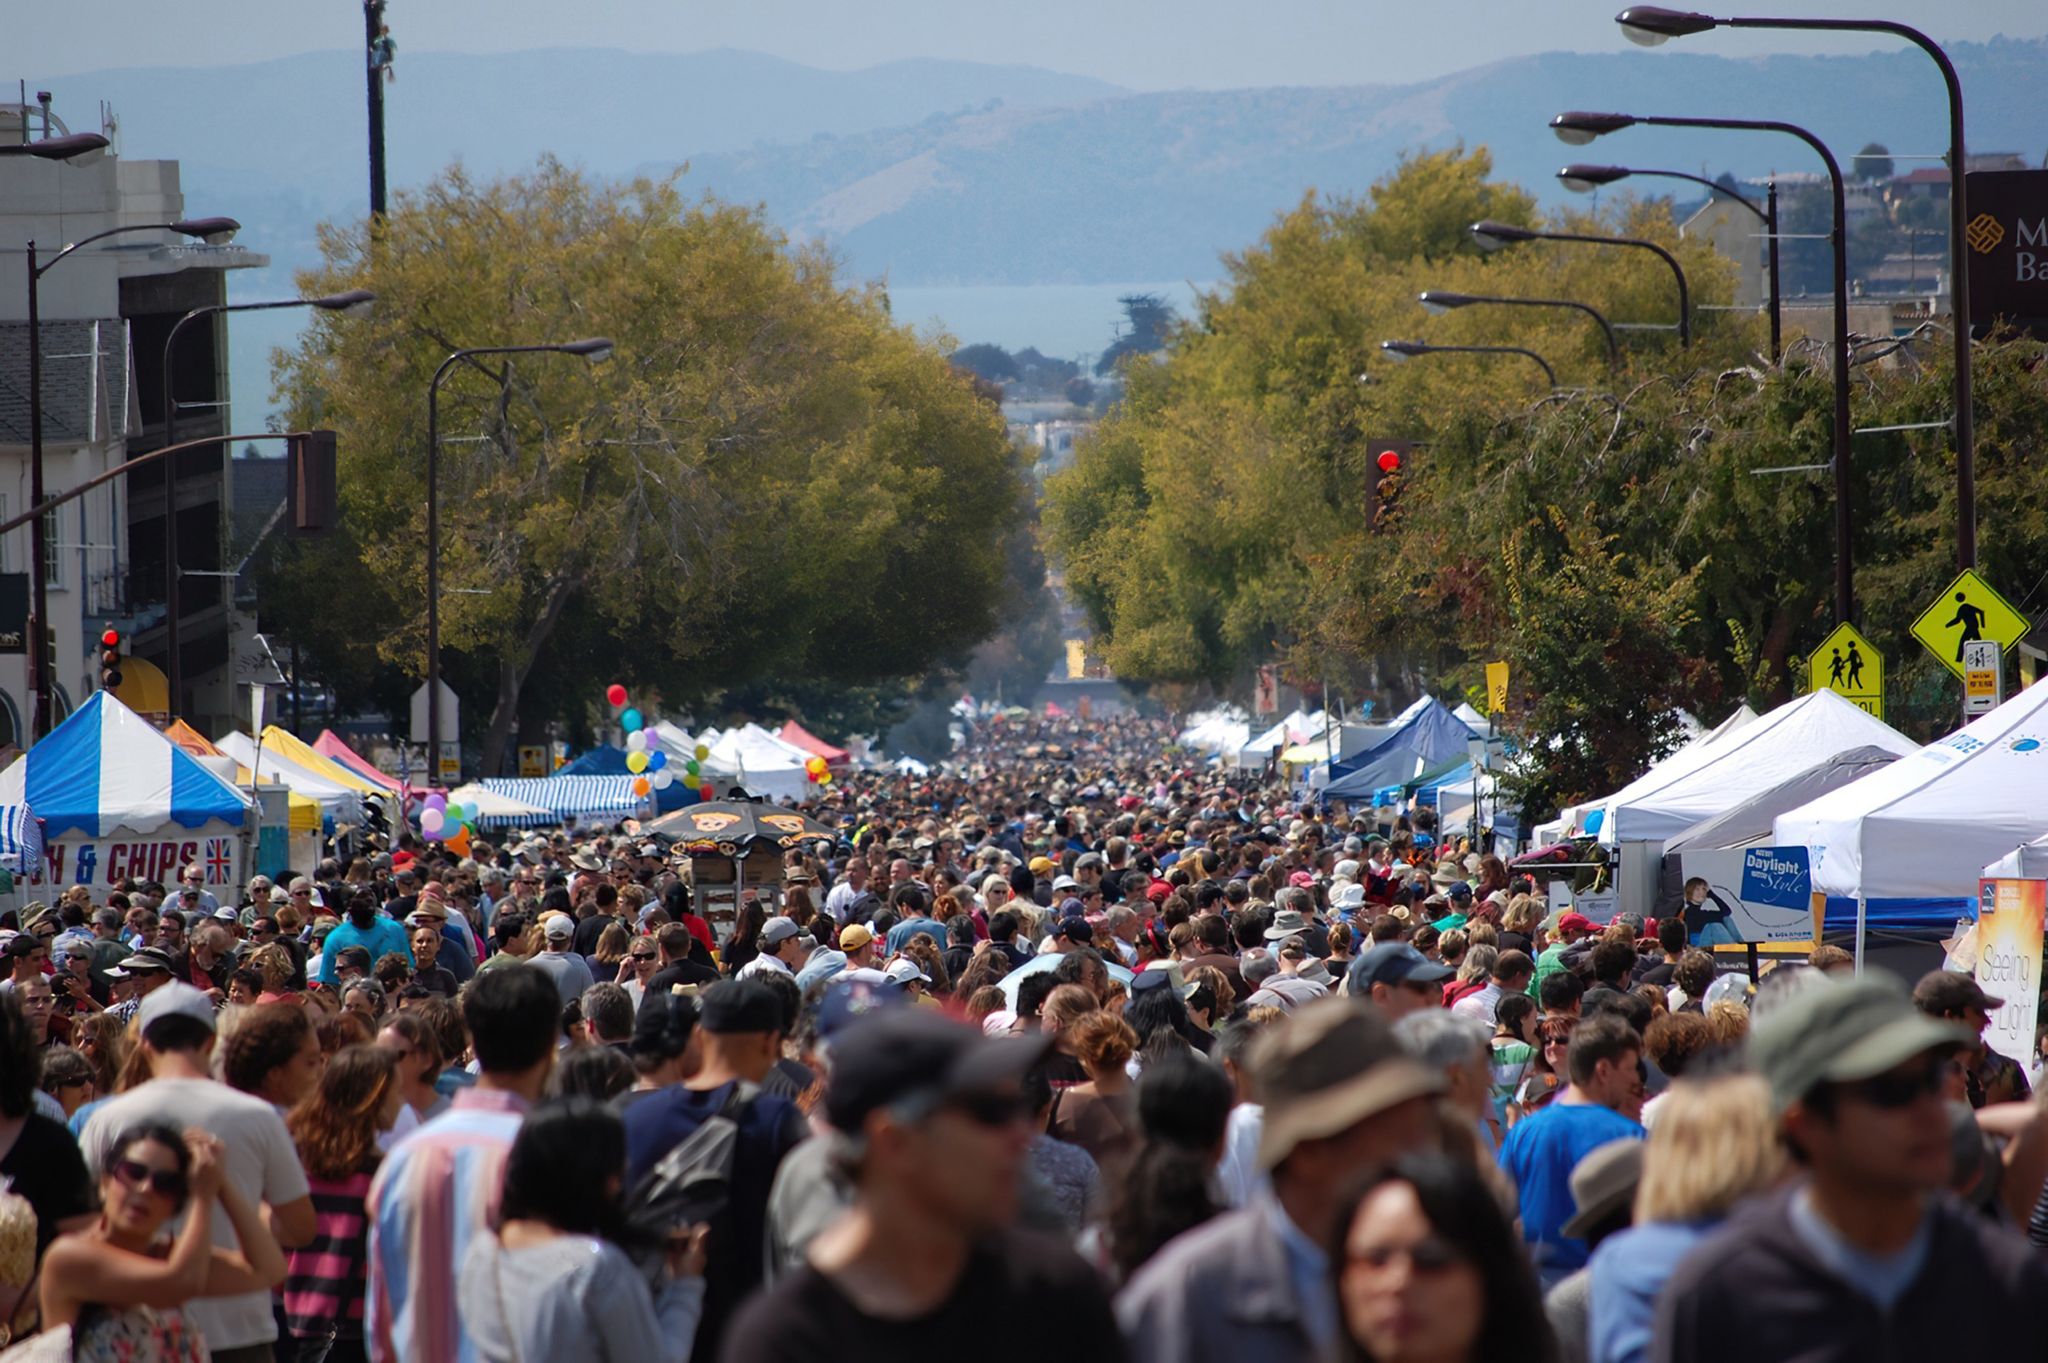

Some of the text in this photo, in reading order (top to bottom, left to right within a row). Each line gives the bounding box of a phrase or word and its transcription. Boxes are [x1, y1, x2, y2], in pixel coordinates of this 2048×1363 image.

[76, 844, 97, 885] &
[107, 842, 198, 884] CHIPS
[1746, 854, 1799, 875] Daylight
[1761, 869, 1808, 903] Style
[1982, 943, 2030, 992] Seeing
